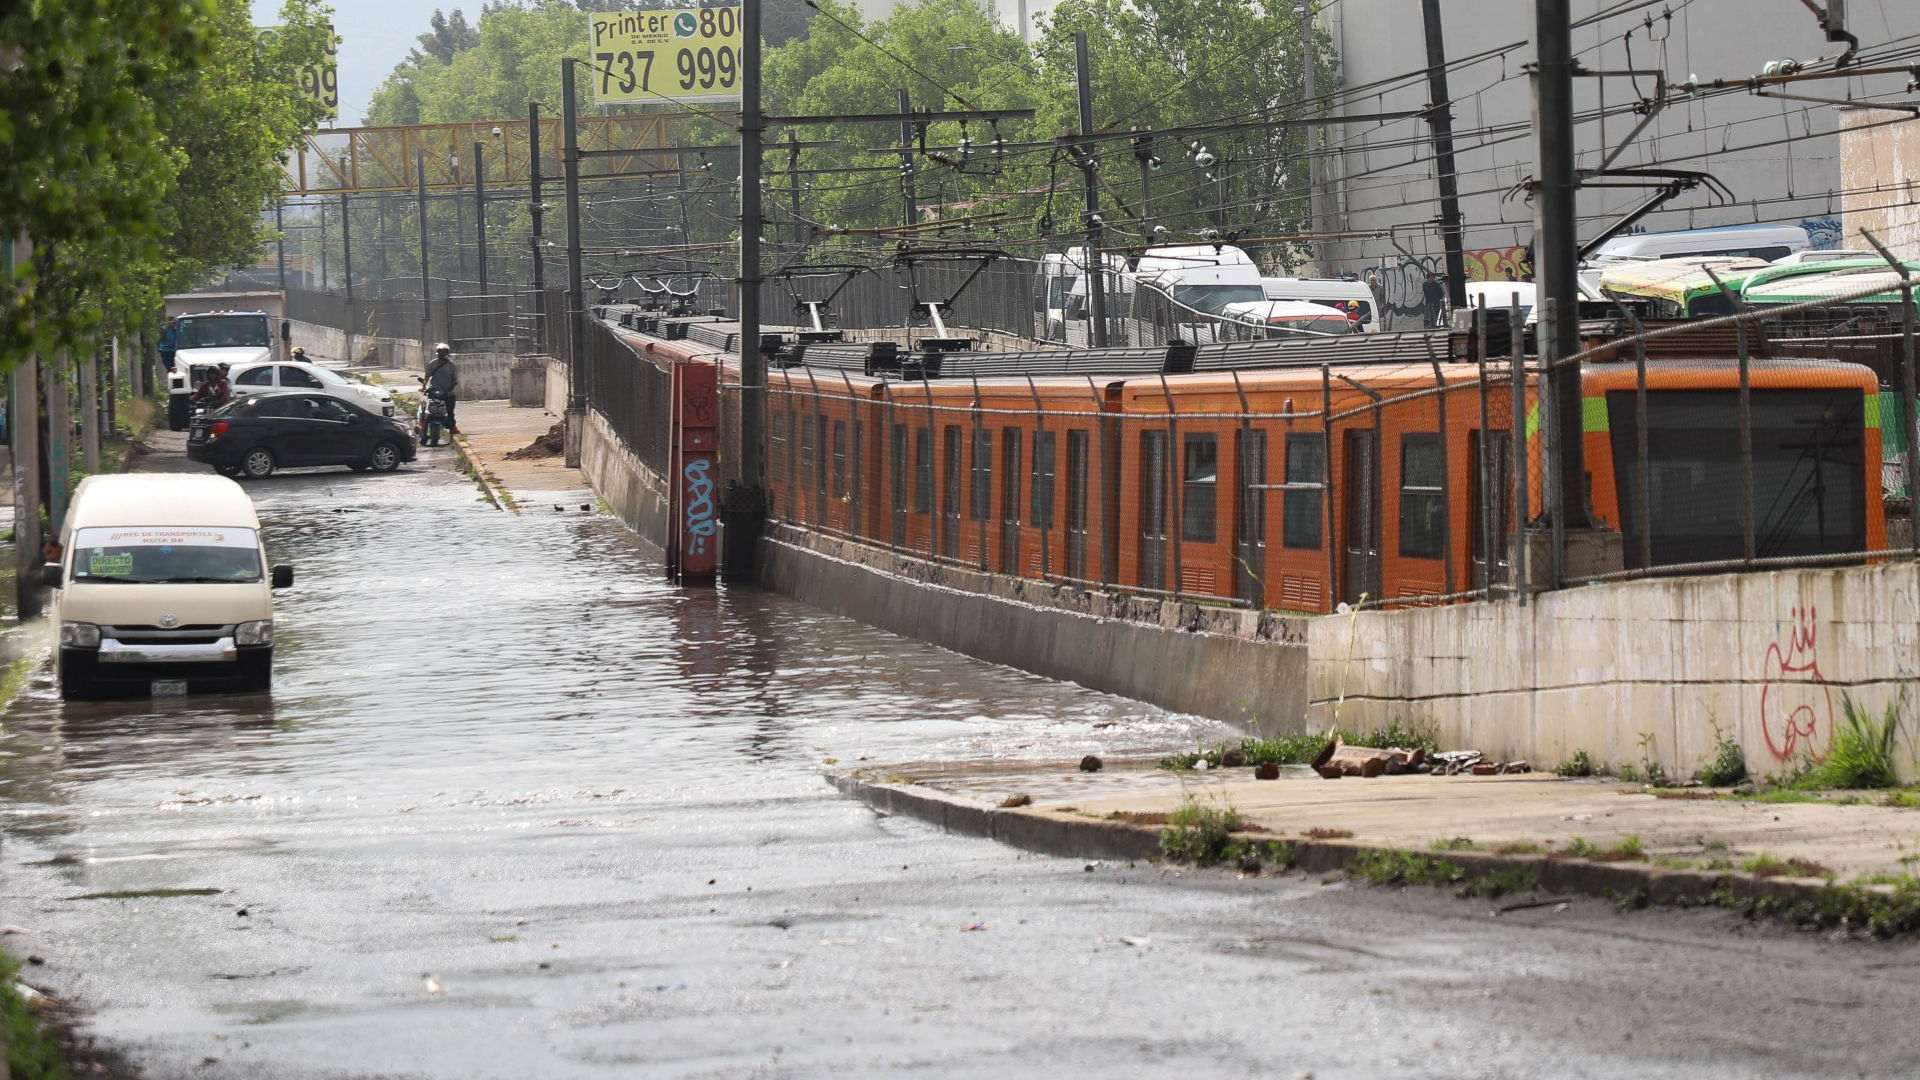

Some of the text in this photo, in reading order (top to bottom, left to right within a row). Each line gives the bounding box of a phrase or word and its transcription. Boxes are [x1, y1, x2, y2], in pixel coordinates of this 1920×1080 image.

[593, 12, 668, 47] Printer
[700, 8, 742, 38] 80
[596, 46, 742, 95] 737 999
